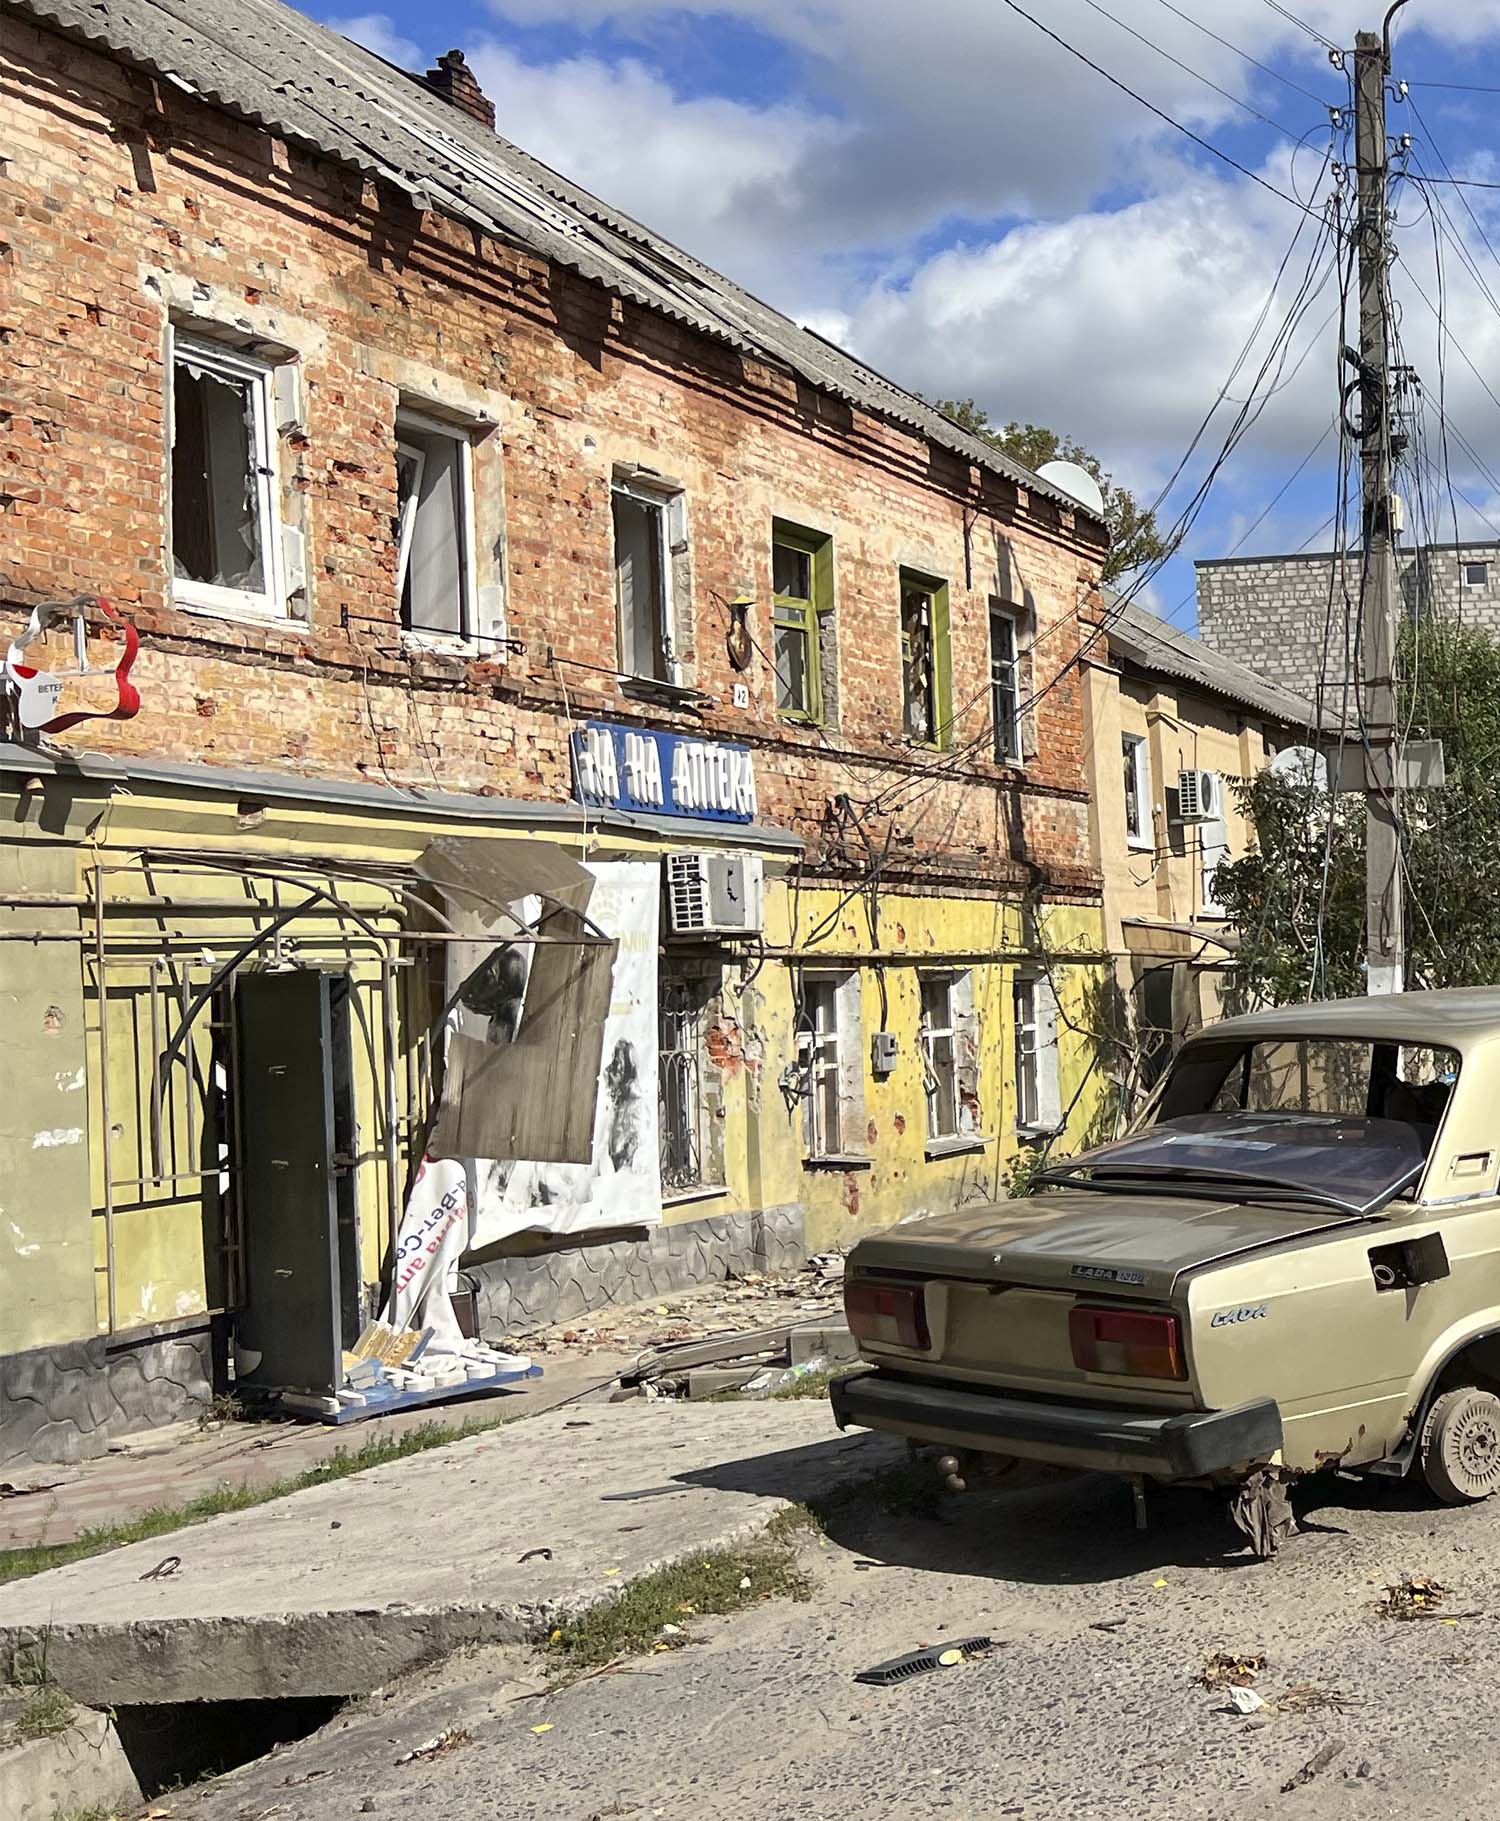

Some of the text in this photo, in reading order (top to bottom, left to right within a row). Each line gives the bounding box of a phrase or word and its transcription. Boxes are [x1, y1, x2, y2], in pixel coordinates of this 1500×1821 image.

[671, 741, 758, 816] АПТЕКА
[1076, 1266, 1114, 1279] LADA
[1210, 1304, 1267, 1328] LADA
